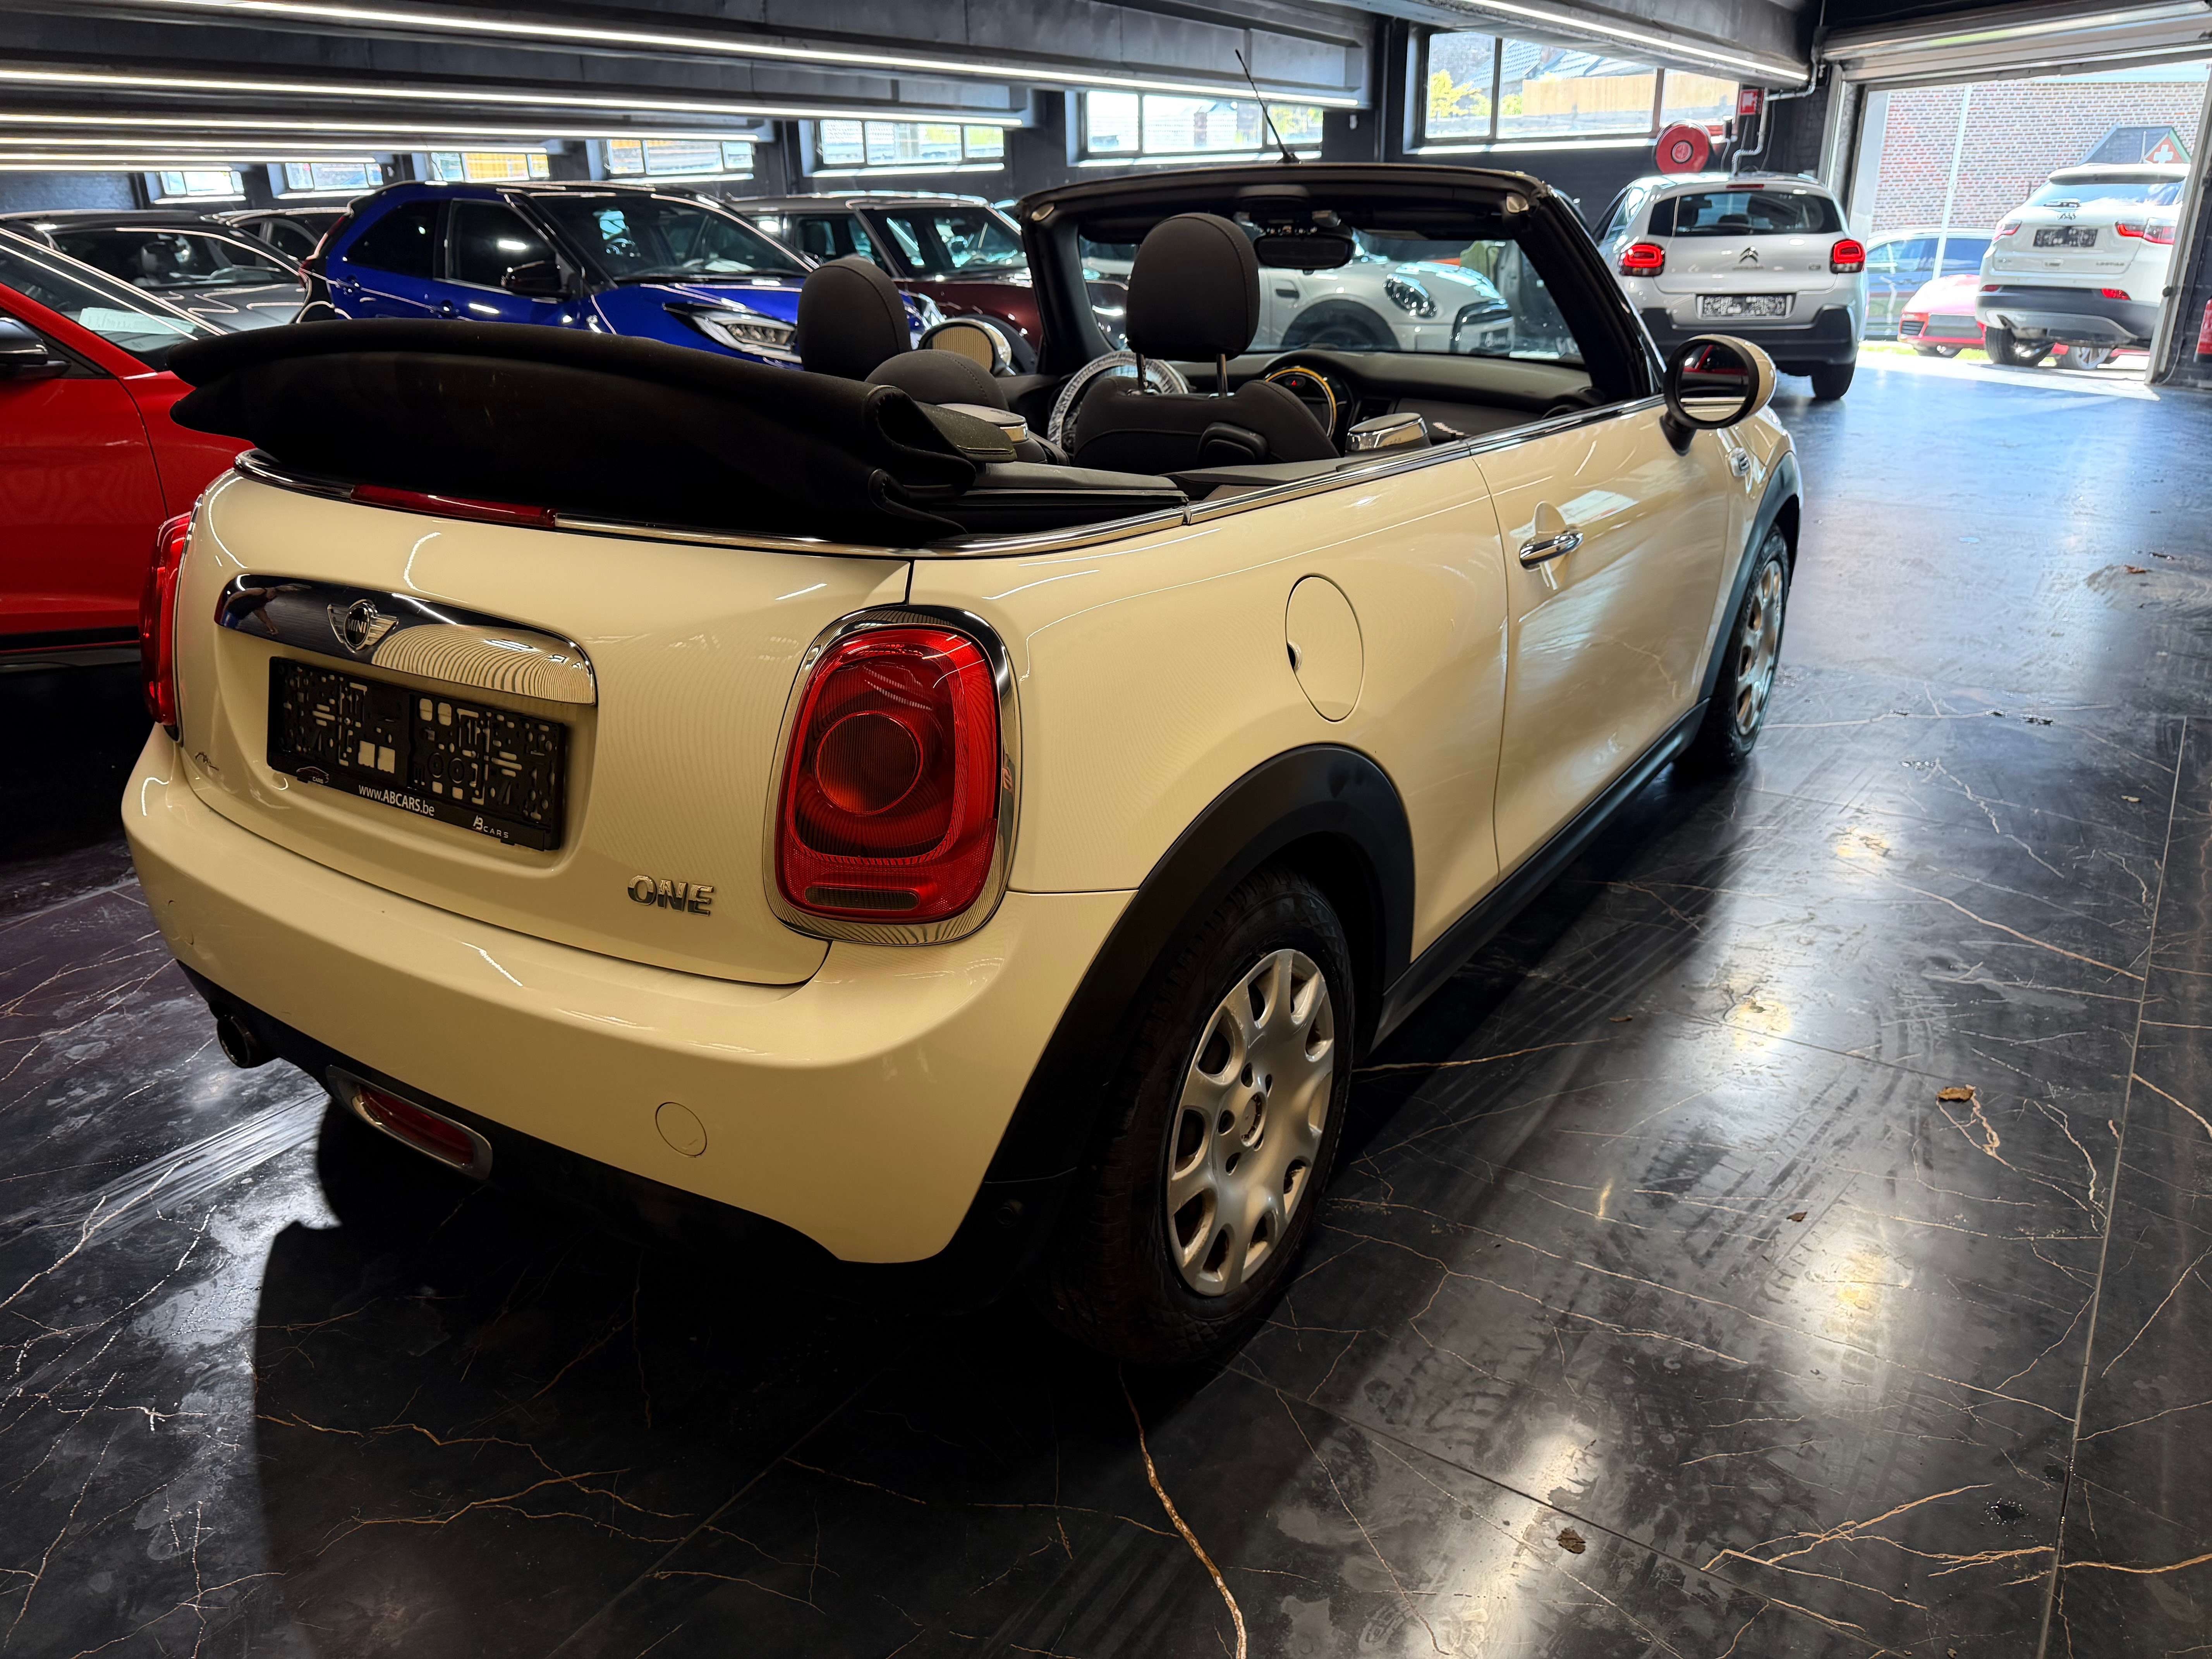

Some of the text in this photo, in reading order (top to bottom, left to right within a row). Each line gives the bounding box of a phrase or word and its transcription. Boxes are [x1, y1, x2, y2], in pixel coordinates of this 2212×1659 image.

[347, 619, 367, 633] MINI
[359, 785, 434, 816] www.ABCARS.be
[627, 874, 714, 916] ONE
